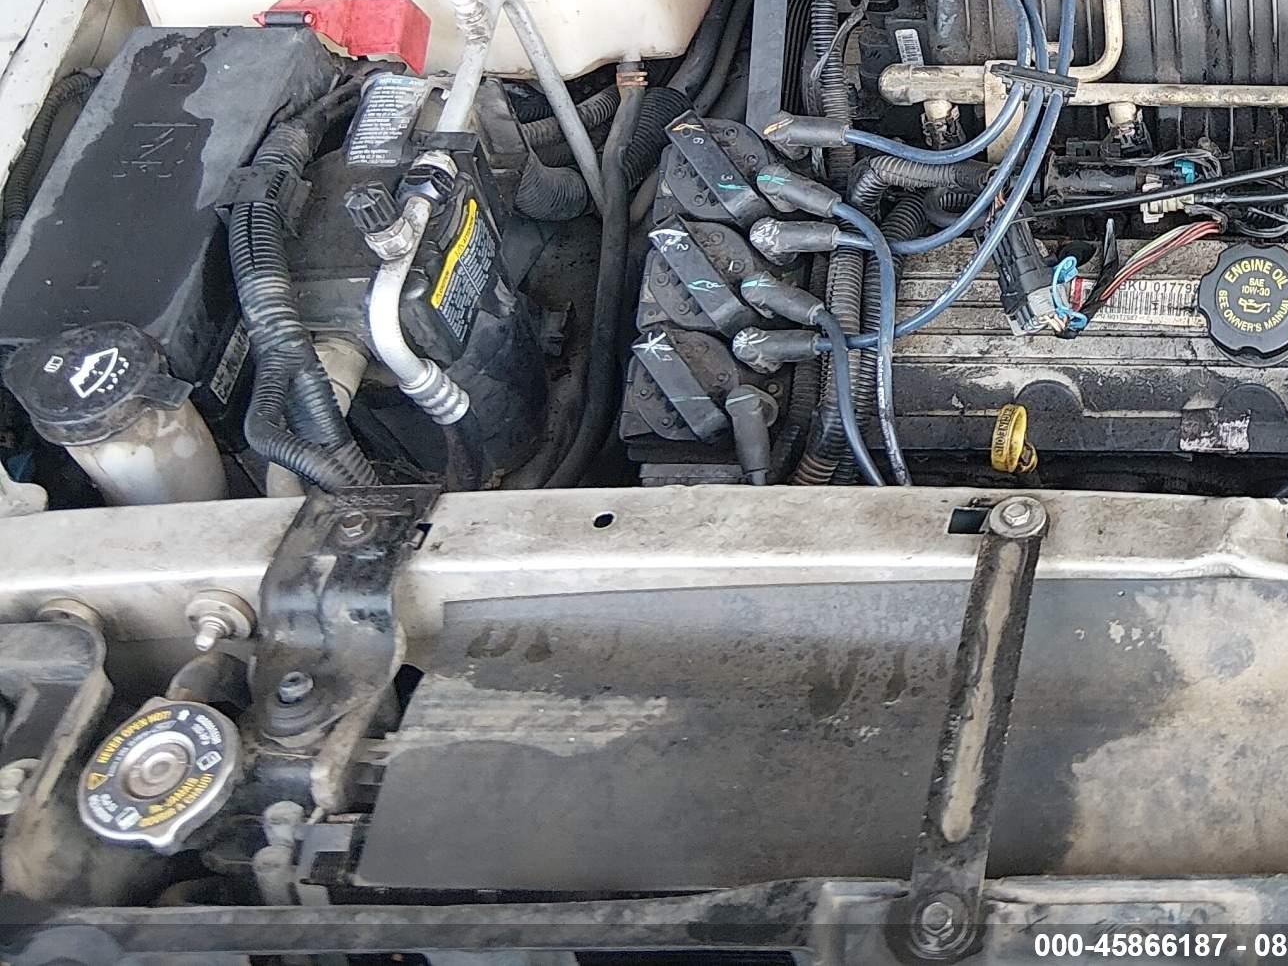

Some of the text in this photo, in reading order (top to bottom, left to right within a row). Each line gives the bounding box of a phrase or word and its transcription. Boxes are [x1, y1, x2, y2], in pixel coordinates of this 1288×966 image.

[1224, 258, 1273, 284] ENGINE
[1241, 285, 1271, 297] 10W-30
[1248, 277, 1265, 288] SAE
[1218, 289, 1230, 310] SEE
[1223, 308, 1262, 332] OWNER'S
[122, 717, 149, 738] OPEN
